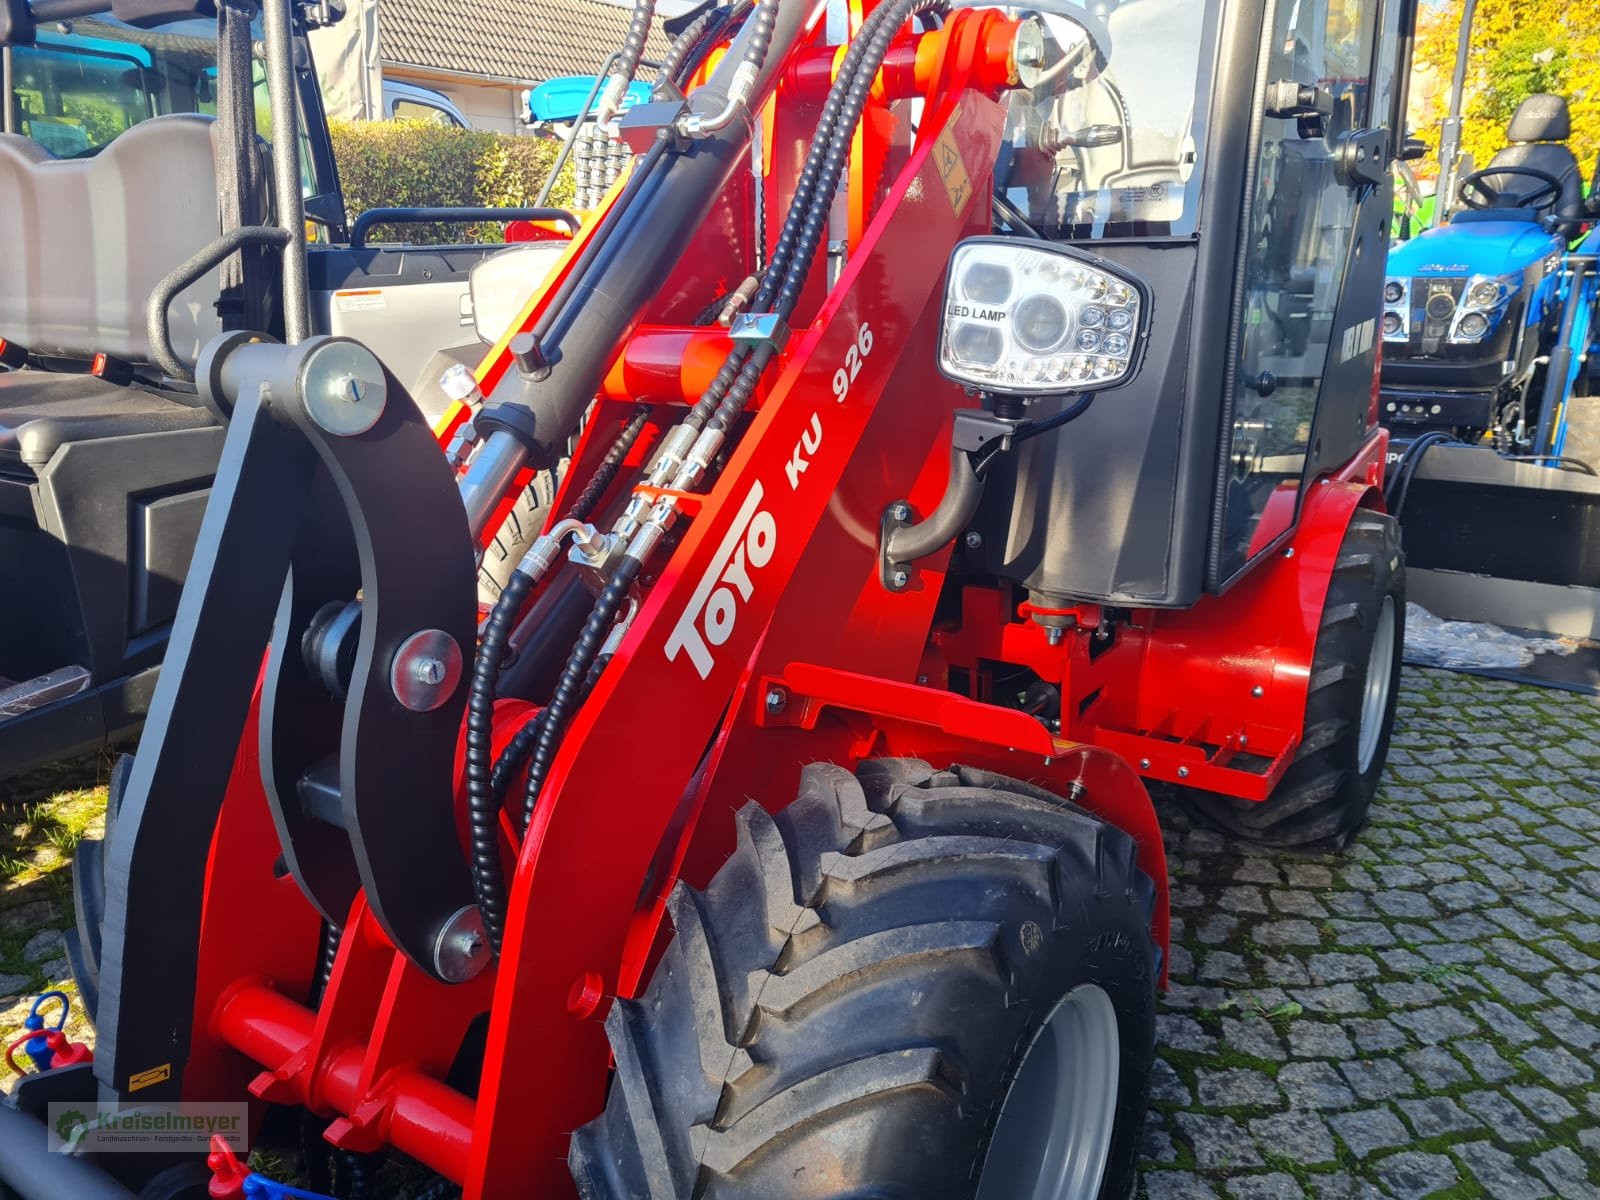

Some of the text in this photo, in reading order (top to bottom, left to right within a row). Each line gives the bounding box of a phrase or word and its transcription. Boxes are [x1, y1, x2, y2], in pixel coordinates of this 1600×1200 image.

[947, 304, 1006, 322] LED LAMP
[785, 412, 823, 490] KU
[832, 322, 874, 403] 926
